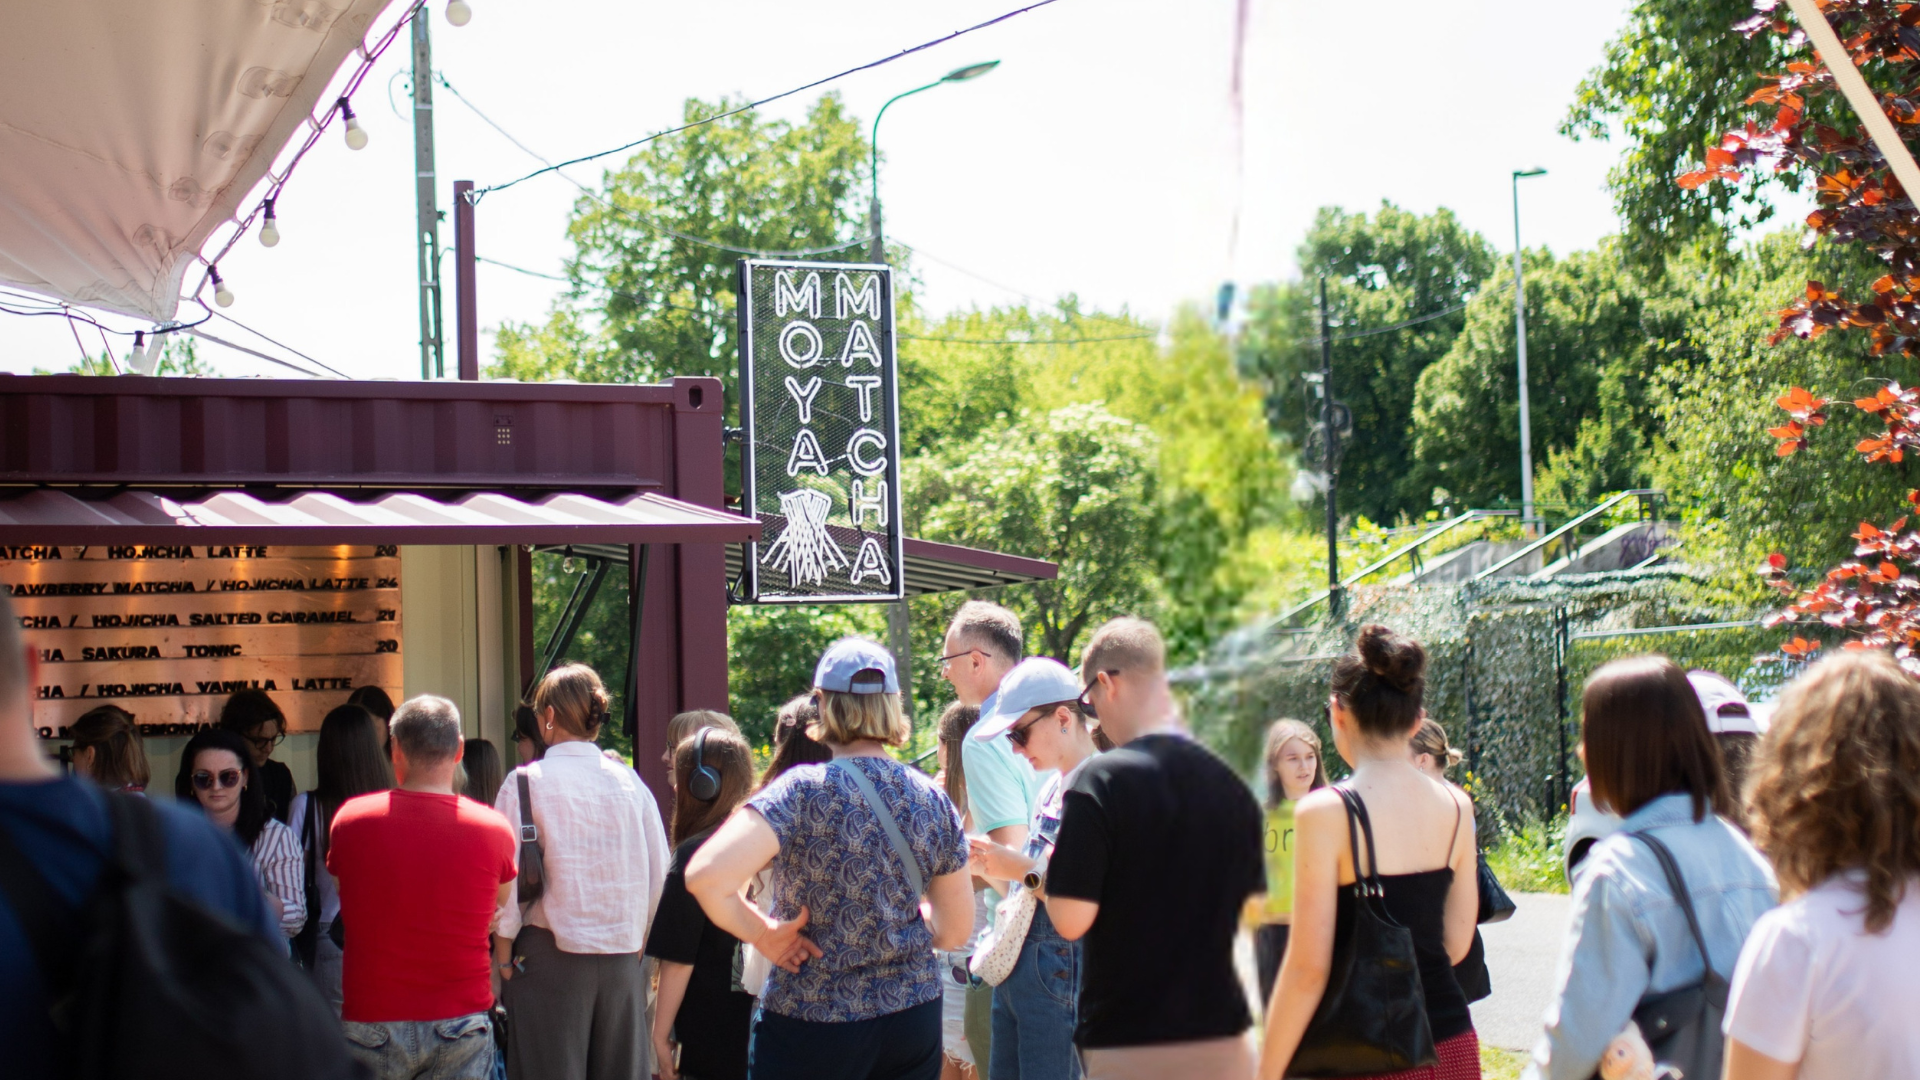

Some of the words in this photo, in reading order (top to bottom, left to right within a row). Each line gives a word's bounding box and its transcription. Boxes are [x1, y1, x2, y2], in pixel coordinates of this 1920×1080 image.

[775, 271, 828, 477] MOYA
[835, 273, 892, 585] MATCHA
[207, 546, 267, 558] LATTE
[375, 545, 397, 557] 20
[113, 582, 196, 593] MATCHA
[221, 579, 304, 591] HOJICHA
[310, 578, 369, 589] LATTE
[376, 577, 398, 588] 24
[18, 616, 62, 628] CHA
[92, 614, 179, 627] HOJICHA
[189, 612, 261, 625] SALTED
[267, 611, 356, 624] CARAMEL
[376, 610, 396, 621] 21
[82, 646, 161, 660] SAKURA
[182, 644, 242, 657] TONIC
[376, 640, 398, 652] 20
[292, 678, 352, 690] LATTE
